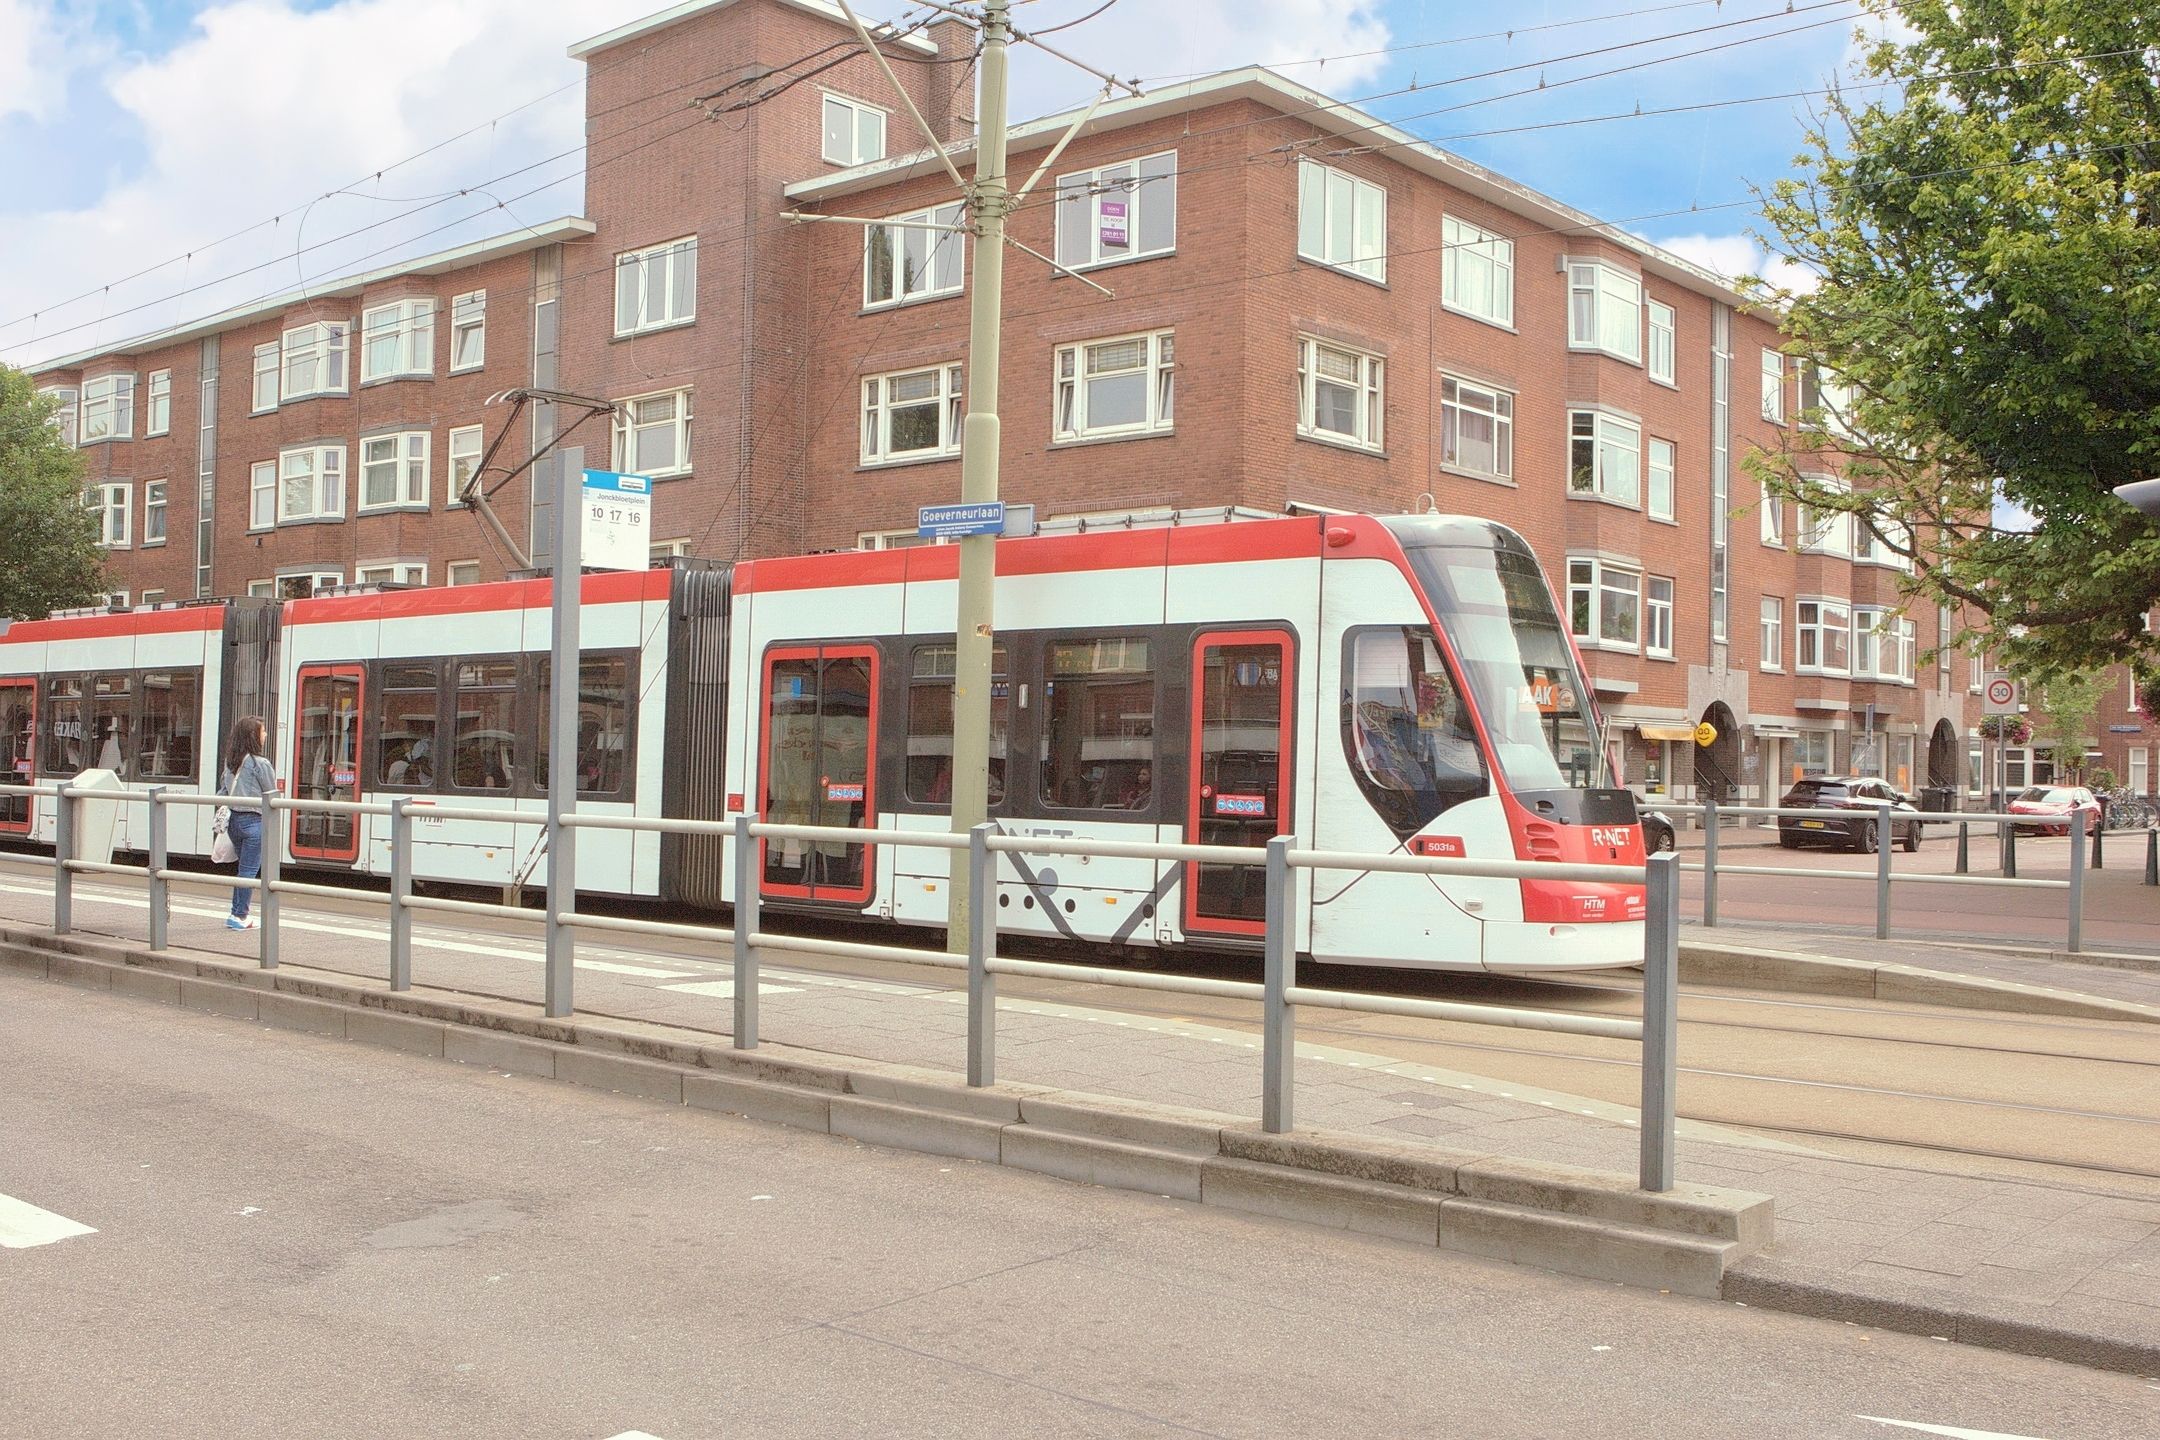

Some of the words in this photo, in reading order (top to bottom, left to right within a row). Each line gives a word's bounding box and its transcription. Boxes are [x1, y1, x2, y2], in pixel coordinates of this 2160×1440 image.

[597, 493, 646, 505] Jonckbloetplein
[591, 507, 604, 518] 10
[609, 510, 622, 521] 17
[628, 512, 641, 523] 16
[922, 507, 999, 522] Goeverneurlaan
[1993, 687, 2009, 697] 30
[1428, 842, 1456, 852] 5031a
[1583, 899, 1606, 910] HTM
